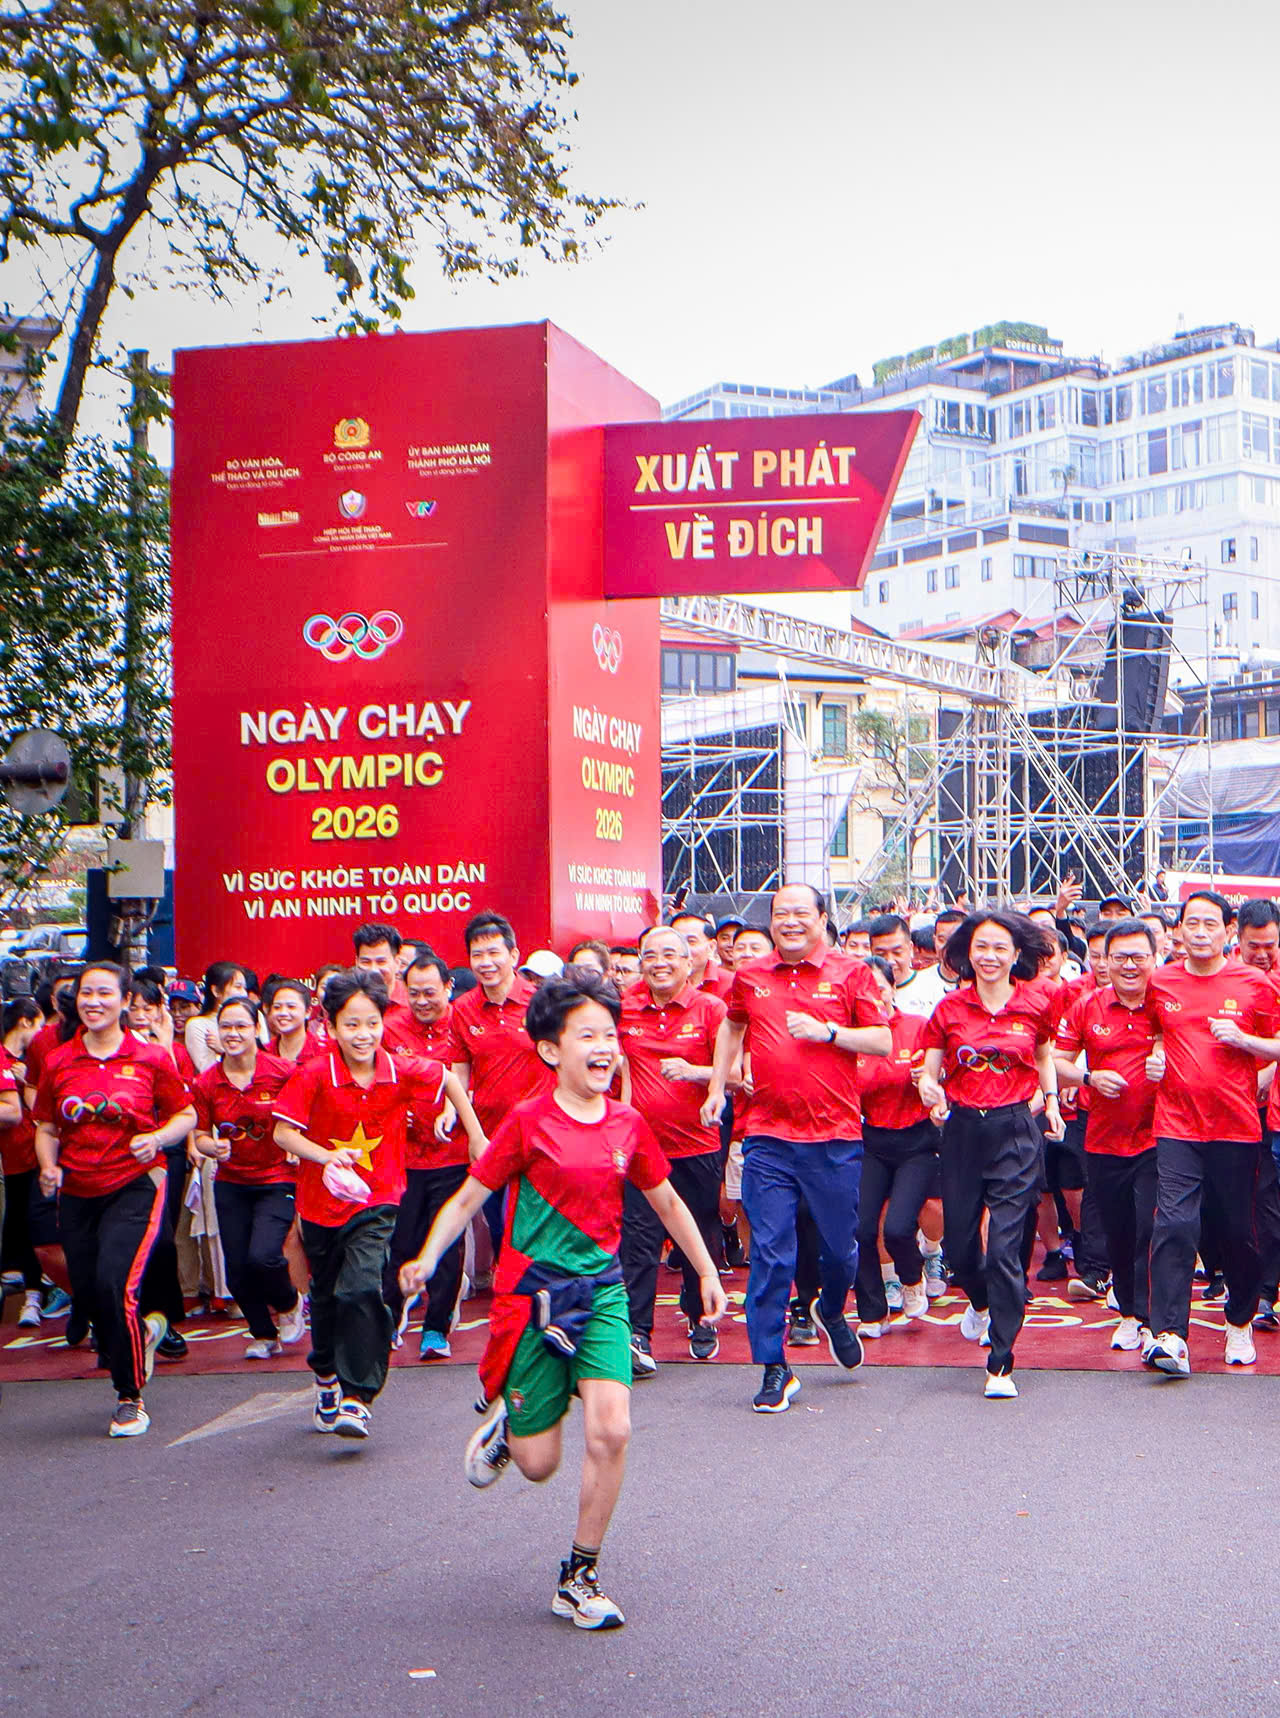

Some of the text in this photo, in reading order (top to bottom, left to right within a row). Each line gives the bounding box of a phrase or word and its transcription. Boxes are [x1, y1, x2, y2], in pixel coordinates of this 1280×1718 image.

[323, 450, 382, 463] BỘ CÔNG AN
[408, 442, 490, 456] ỦY BAN NHÂN DÂN
[408, 454, 491, 469] THÀNH PHỐ HÀ NỘI
[211, 467, 300, 482] THỂ THAO VÀ DU LỊCH
[634, 440, 856, 493] XUẤT PHÁT
[405, 500, 436, 517] VTV
[664, 511, 823, 559] VỀ ĐÍCH
[240, 700, 471, 746] NGÀY CHẠY
[573, 704, 641, 757] NGÀY CHẠY
[266, 752, 444, 794] OLYMPIC
[582, 755, 634, 797] OLYMPIC
[311, 805, 399, 841] 2026
[596, 807, 622, 841] 2026
[223, 861, 486, 893] VÌ SỨC KHỎE TOÀN DÂN
[244, 890, 471, 919] VÌ AN NINH TỔ QUỐC
